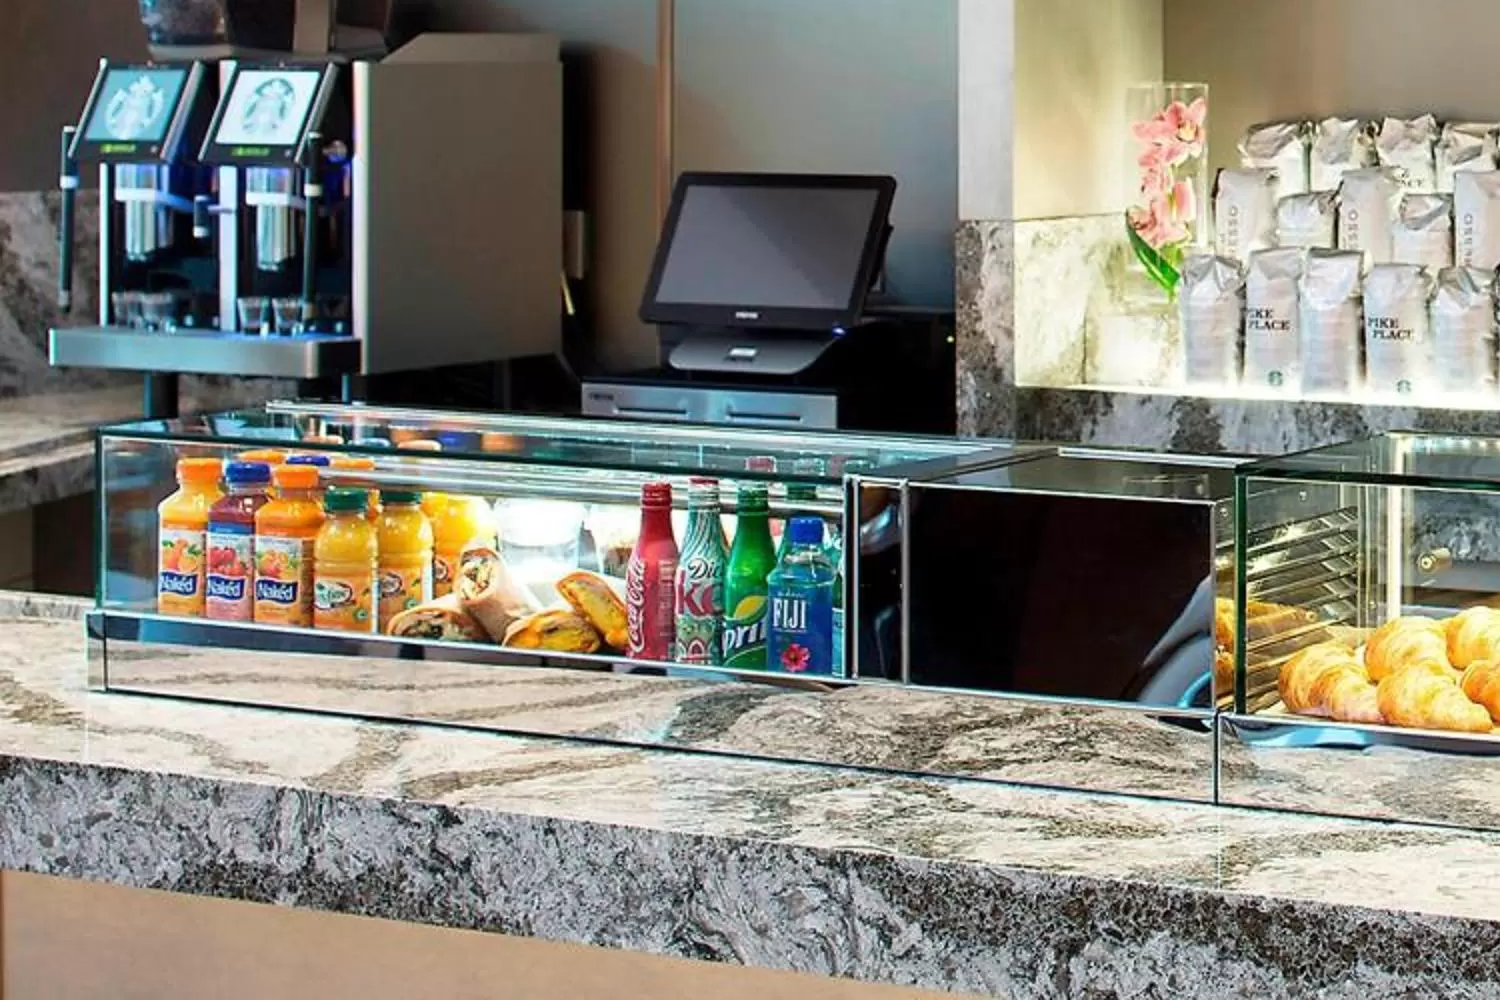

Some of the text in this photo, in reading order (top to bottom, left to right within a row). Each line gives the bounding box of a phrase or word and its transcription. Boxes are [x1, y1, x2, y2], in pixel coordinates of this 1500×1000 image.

[160, 575, 193, 593] Naked
[207, 579, 241, 597] Naked
[257, 582, 293, 600] Naked
[772, 598, 807, 629] FIJI
